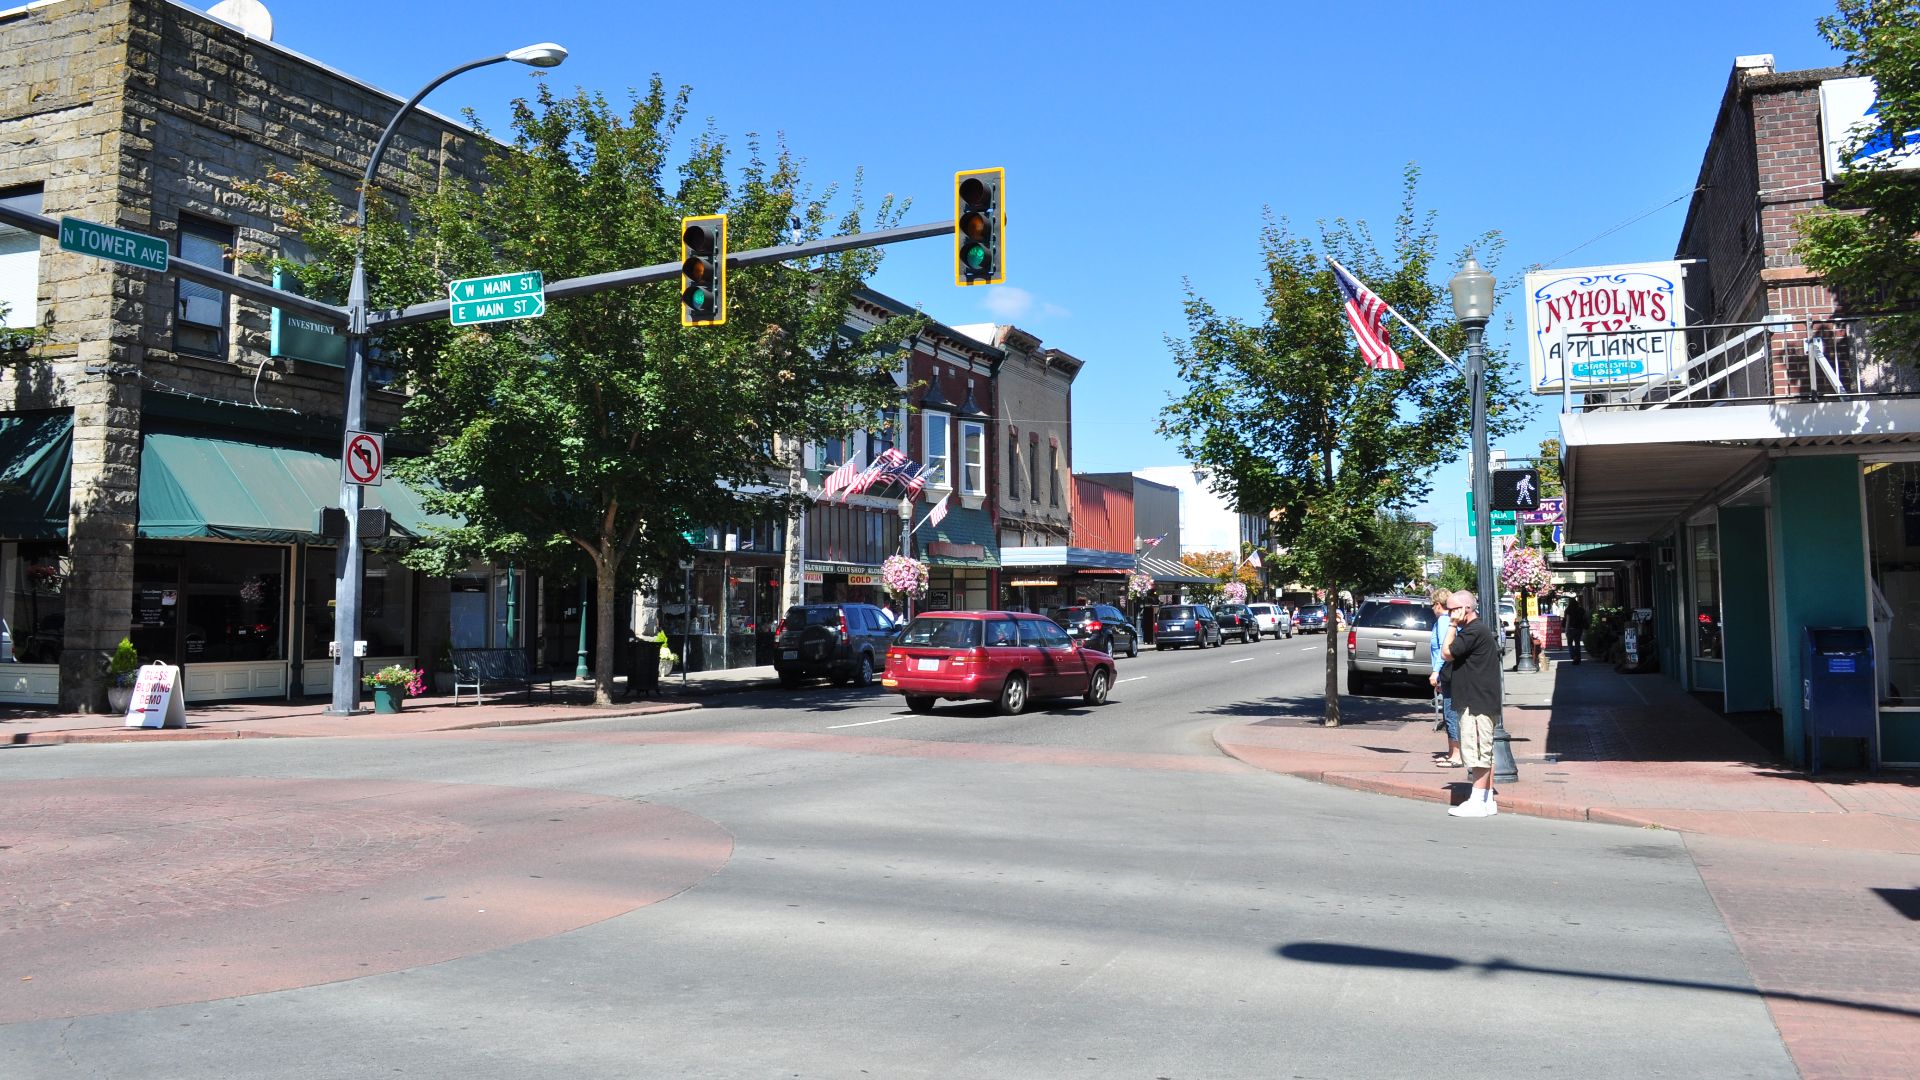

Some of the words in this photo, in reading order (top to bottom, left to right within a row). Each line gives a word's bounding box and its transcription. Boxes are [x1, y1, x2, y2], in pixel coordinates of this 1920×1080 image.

[64, 227, 74, 244] N
[79, 228, 136, 258] TOWER
[140, 247, 165, 264] AVE
[465, 284, 474, 298] W
[483, 279, 511, 295] MAIN
[520, 277, 533, 291] ST
[458, 306, 466, 319] E
[476, 302, 504, 317] MAIN
[513, 300, 527, 313] ST
[1545, 288, 1666, 334] NYHOLM'S
[1580, 319, 1623, 337] TV
[1549, 336, 1664, 360] APPLIANCE
[1577, 361, 1637, 372] ESTABLISHED
[145, 670, 169, 681] GLASS
[136, 682, 171, 693] BLOWING
[140, 694, 162, 705] DEMO
